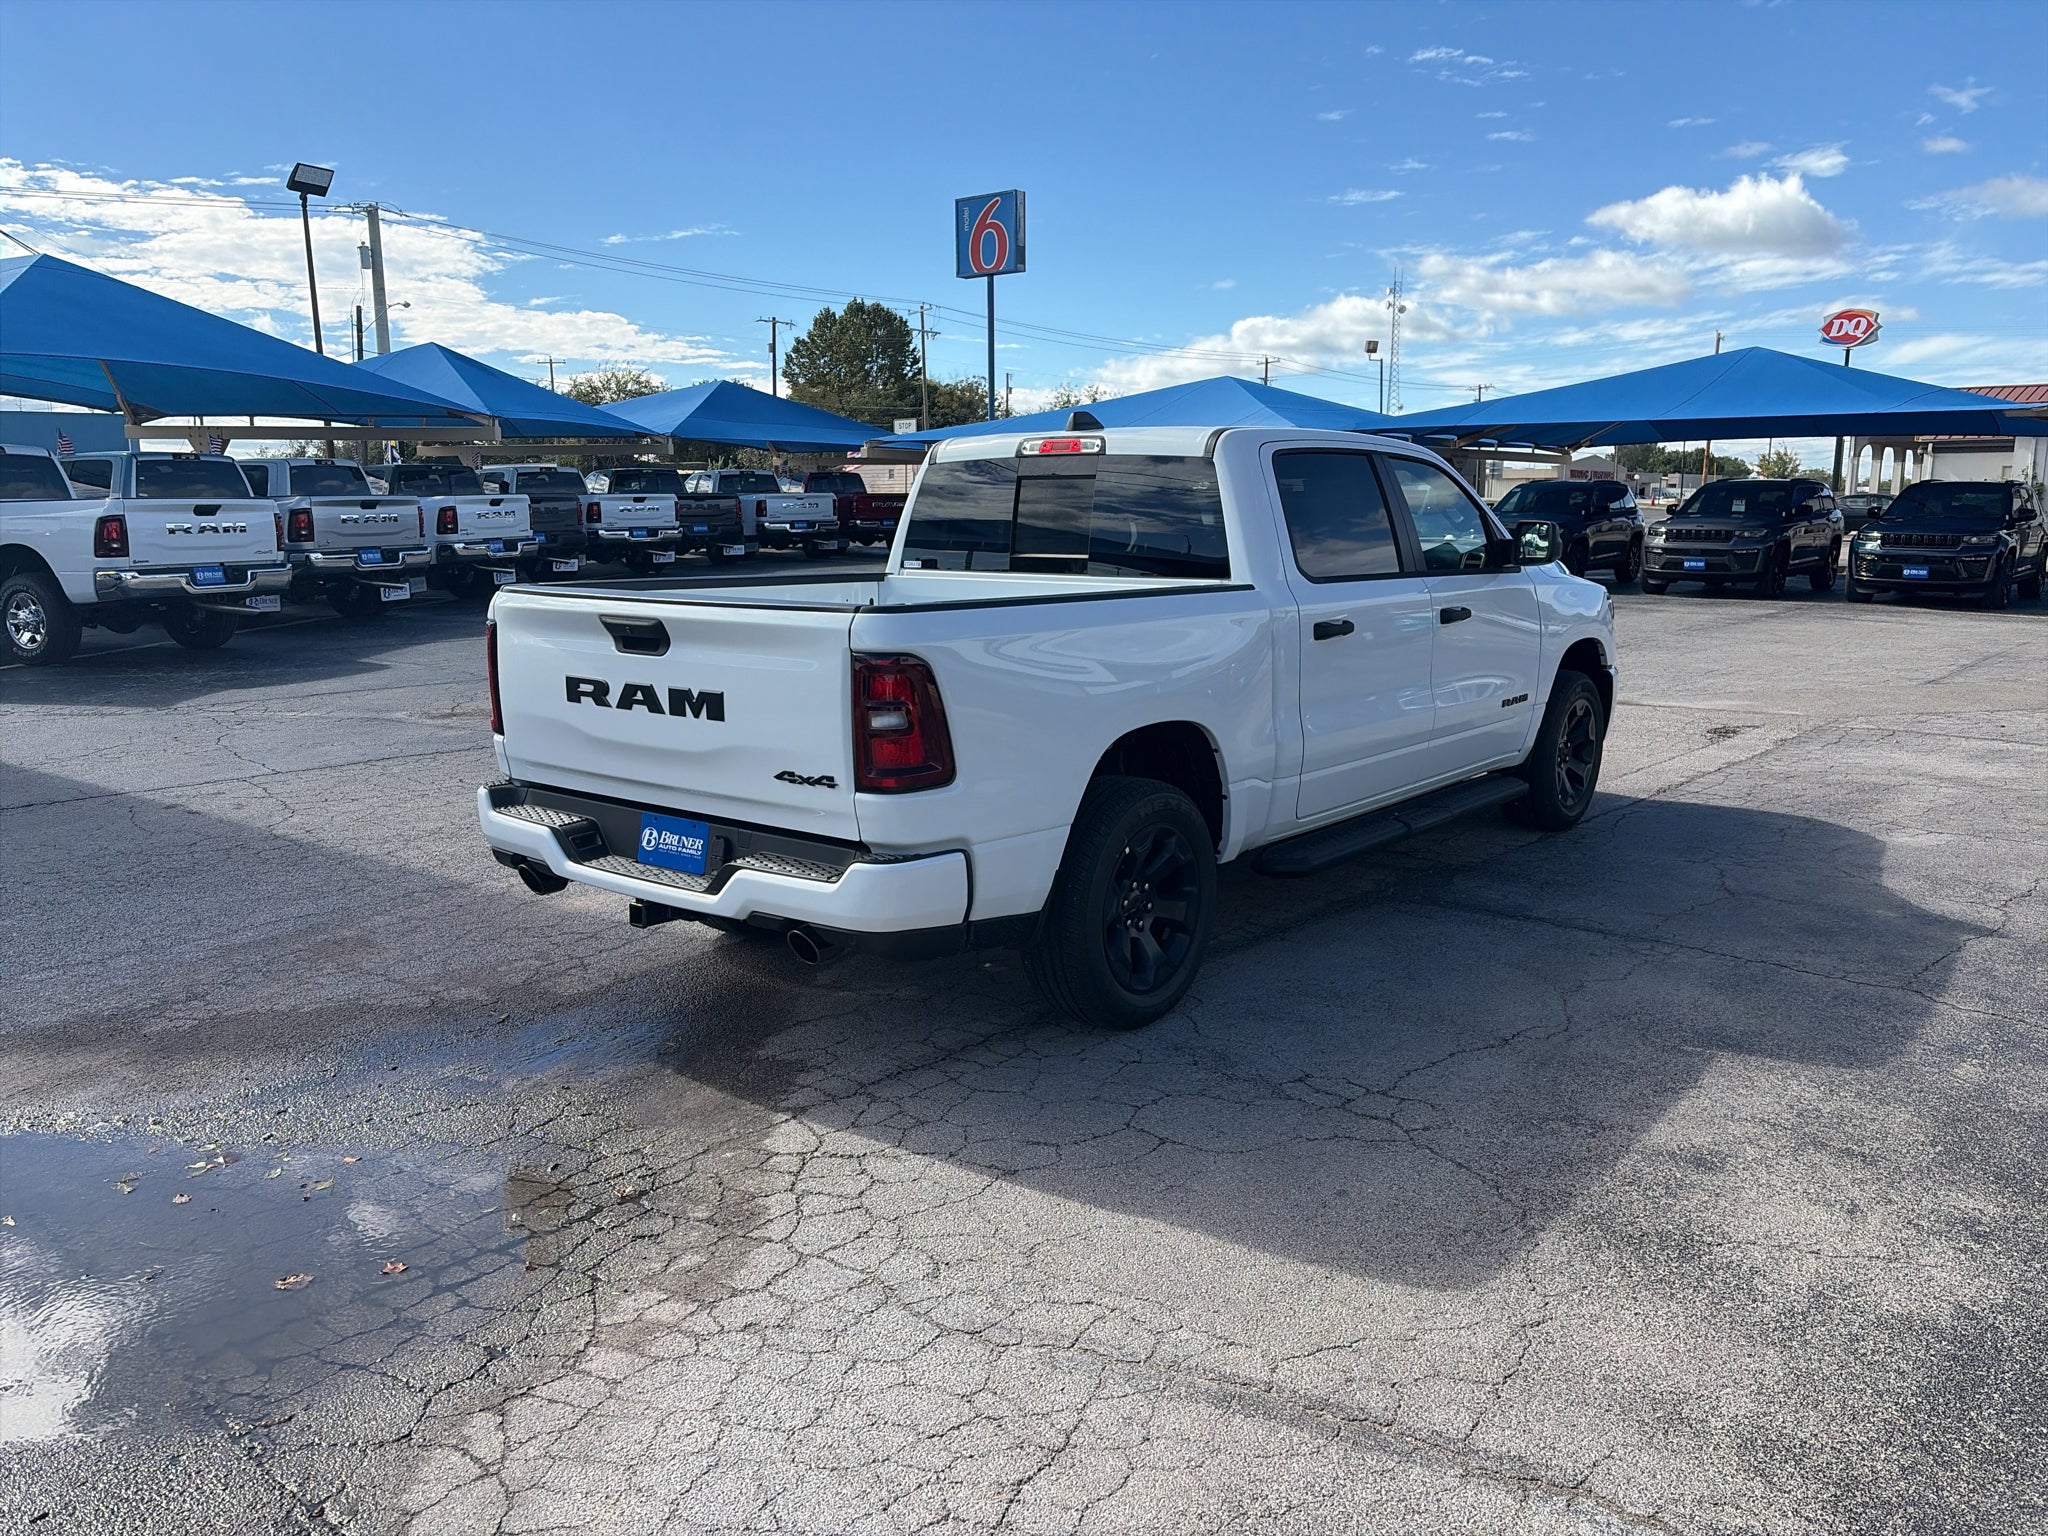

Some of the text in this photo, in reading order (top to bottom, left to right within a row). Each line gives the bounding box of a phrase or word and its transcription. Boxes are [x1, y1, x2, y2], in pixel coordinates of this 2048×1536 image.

[968, 197, 1009, 273] 6
[1829, 317, 1867, 338] DQ
[898, 422, 911, 430] STOP
[475, 510, 516, 520] RAM
[619, 505, 660, 513] RAM
[340, 513, 398, 525] RAM
[166, 522, 247, 535] RAM
[565, 674, 726, 723] RAM
[1501, 693, 1529, 708] RAM
[773, 770, 839, 789] 4x4
[659, 830, 704, 850] BRUNER
[658, 843, 703, 856] AUTO FAMILY
